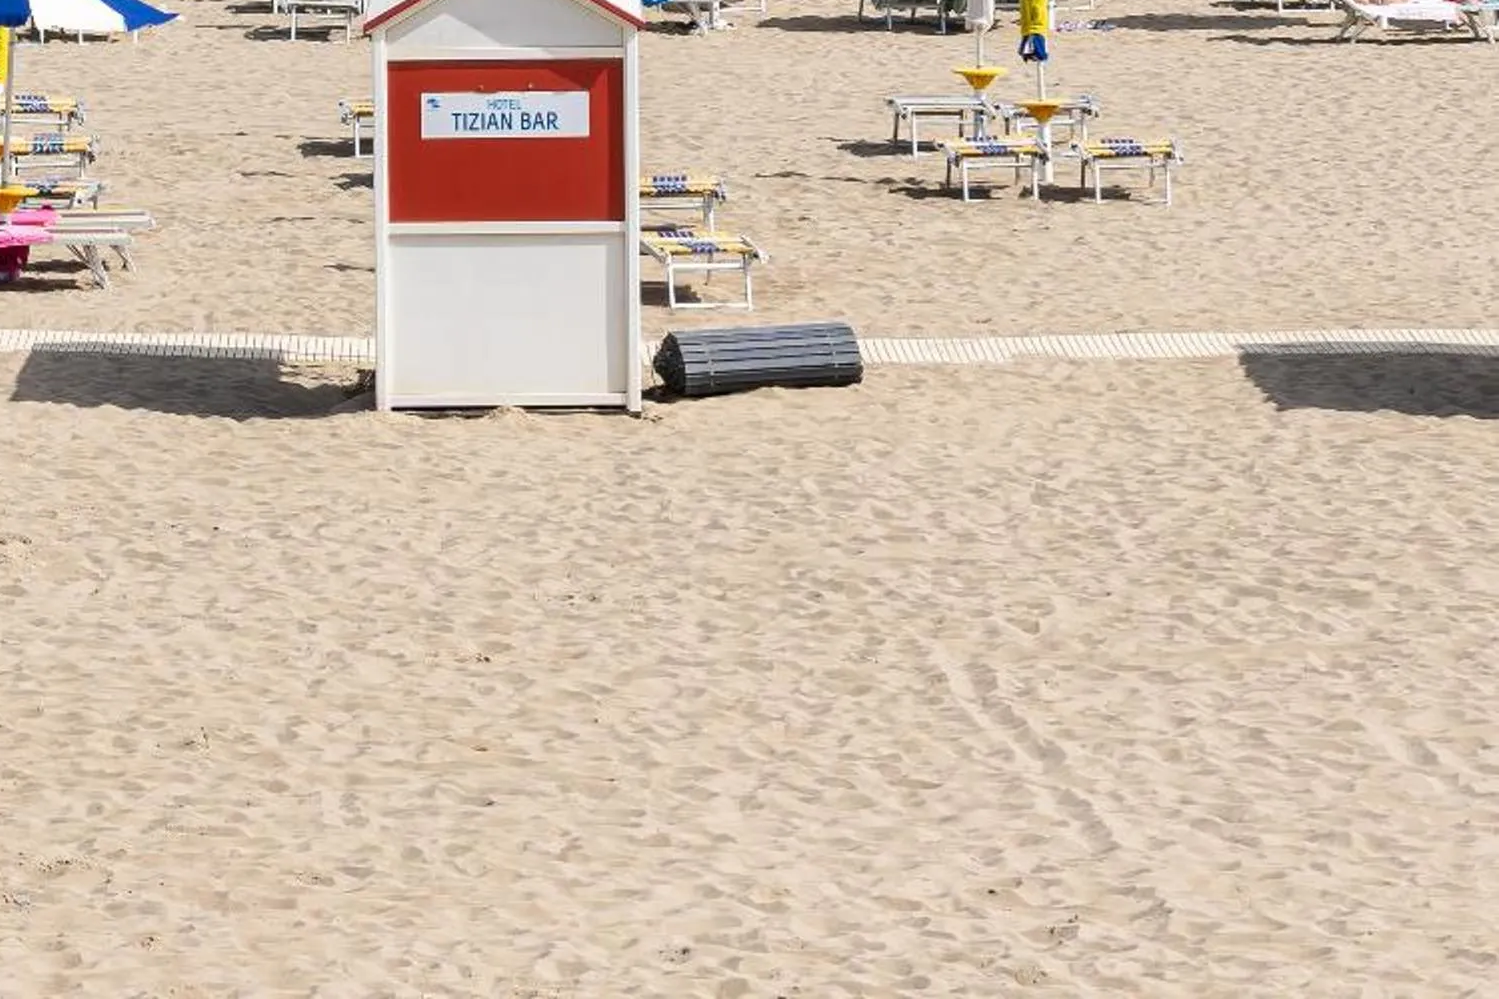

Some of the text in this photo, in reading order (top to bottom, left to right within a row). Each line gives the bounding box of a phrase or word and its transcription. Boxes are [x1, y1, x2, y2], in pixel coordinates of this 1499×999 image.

[487, 99, 522, 110] HOTEL
[452, 111, 559, 131] TIZIAN BAR
